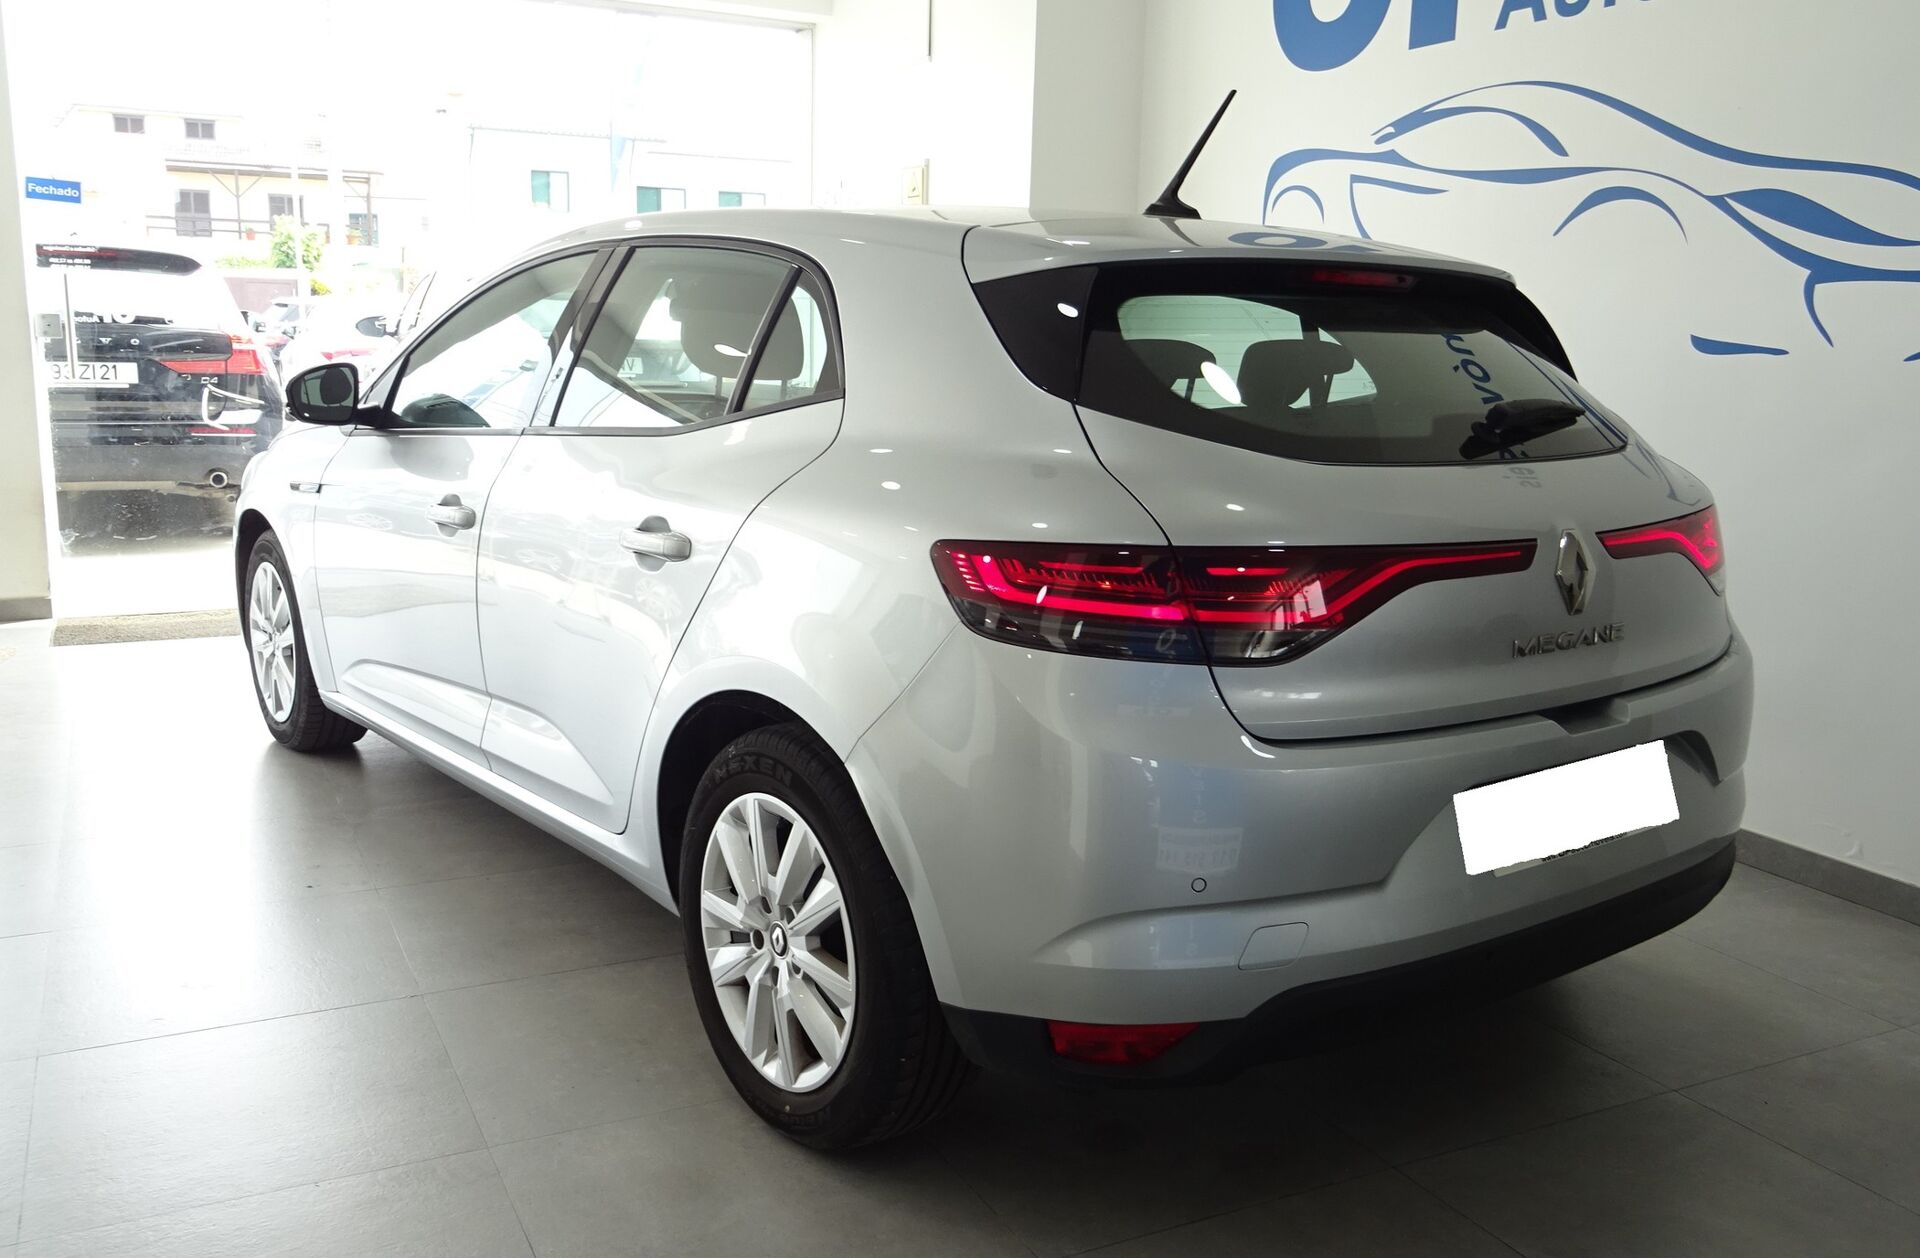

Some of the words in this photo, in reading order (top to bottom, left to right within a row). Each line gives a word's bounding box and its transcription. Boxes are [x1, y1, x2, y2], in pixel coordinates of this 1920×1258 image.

[28, 183, 80, 198] Fechado
[1512, 622, 1625, 658] MEGANE
[713, 755, 794, 786] NEXEN
